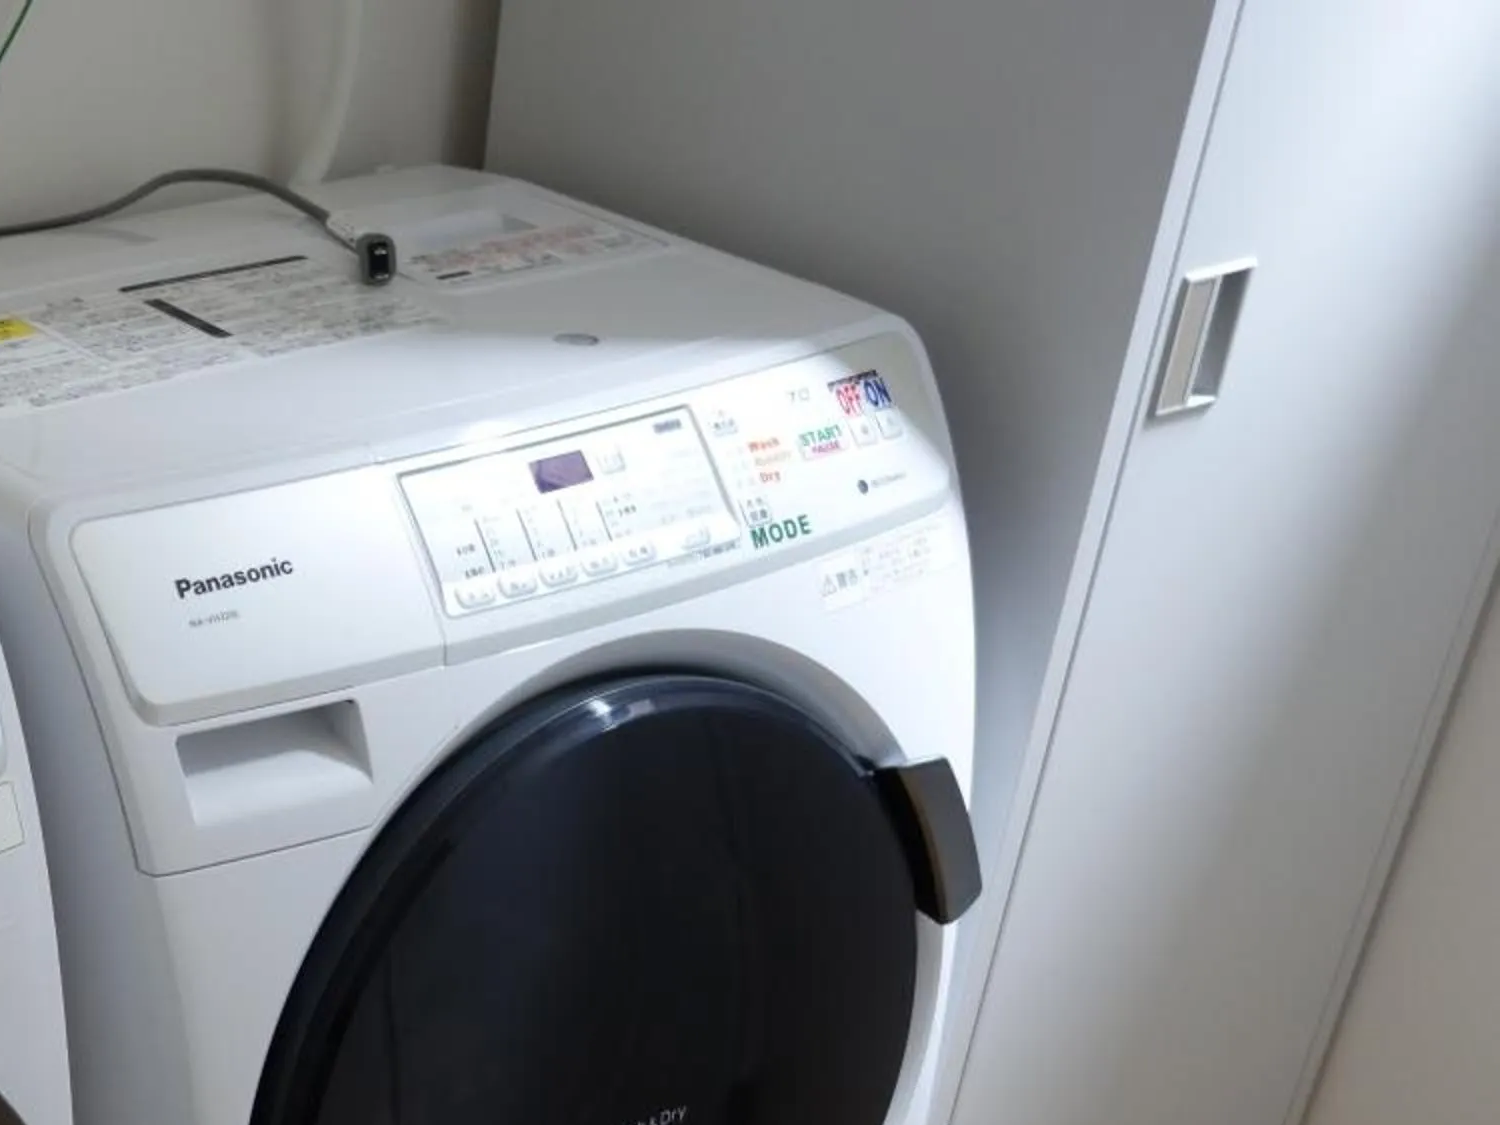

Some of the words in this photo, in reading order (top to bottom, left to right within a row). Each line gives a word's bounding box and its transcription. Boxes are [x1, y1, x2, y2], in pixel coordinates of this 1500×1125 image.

[836, 384, 862, 416] OFF
[864, 377, 892, 406] ON
[798, 424, 842, 446] START
[750, 514, 812, 549] MODE
[175, 557, 294, 599] Panasonic
